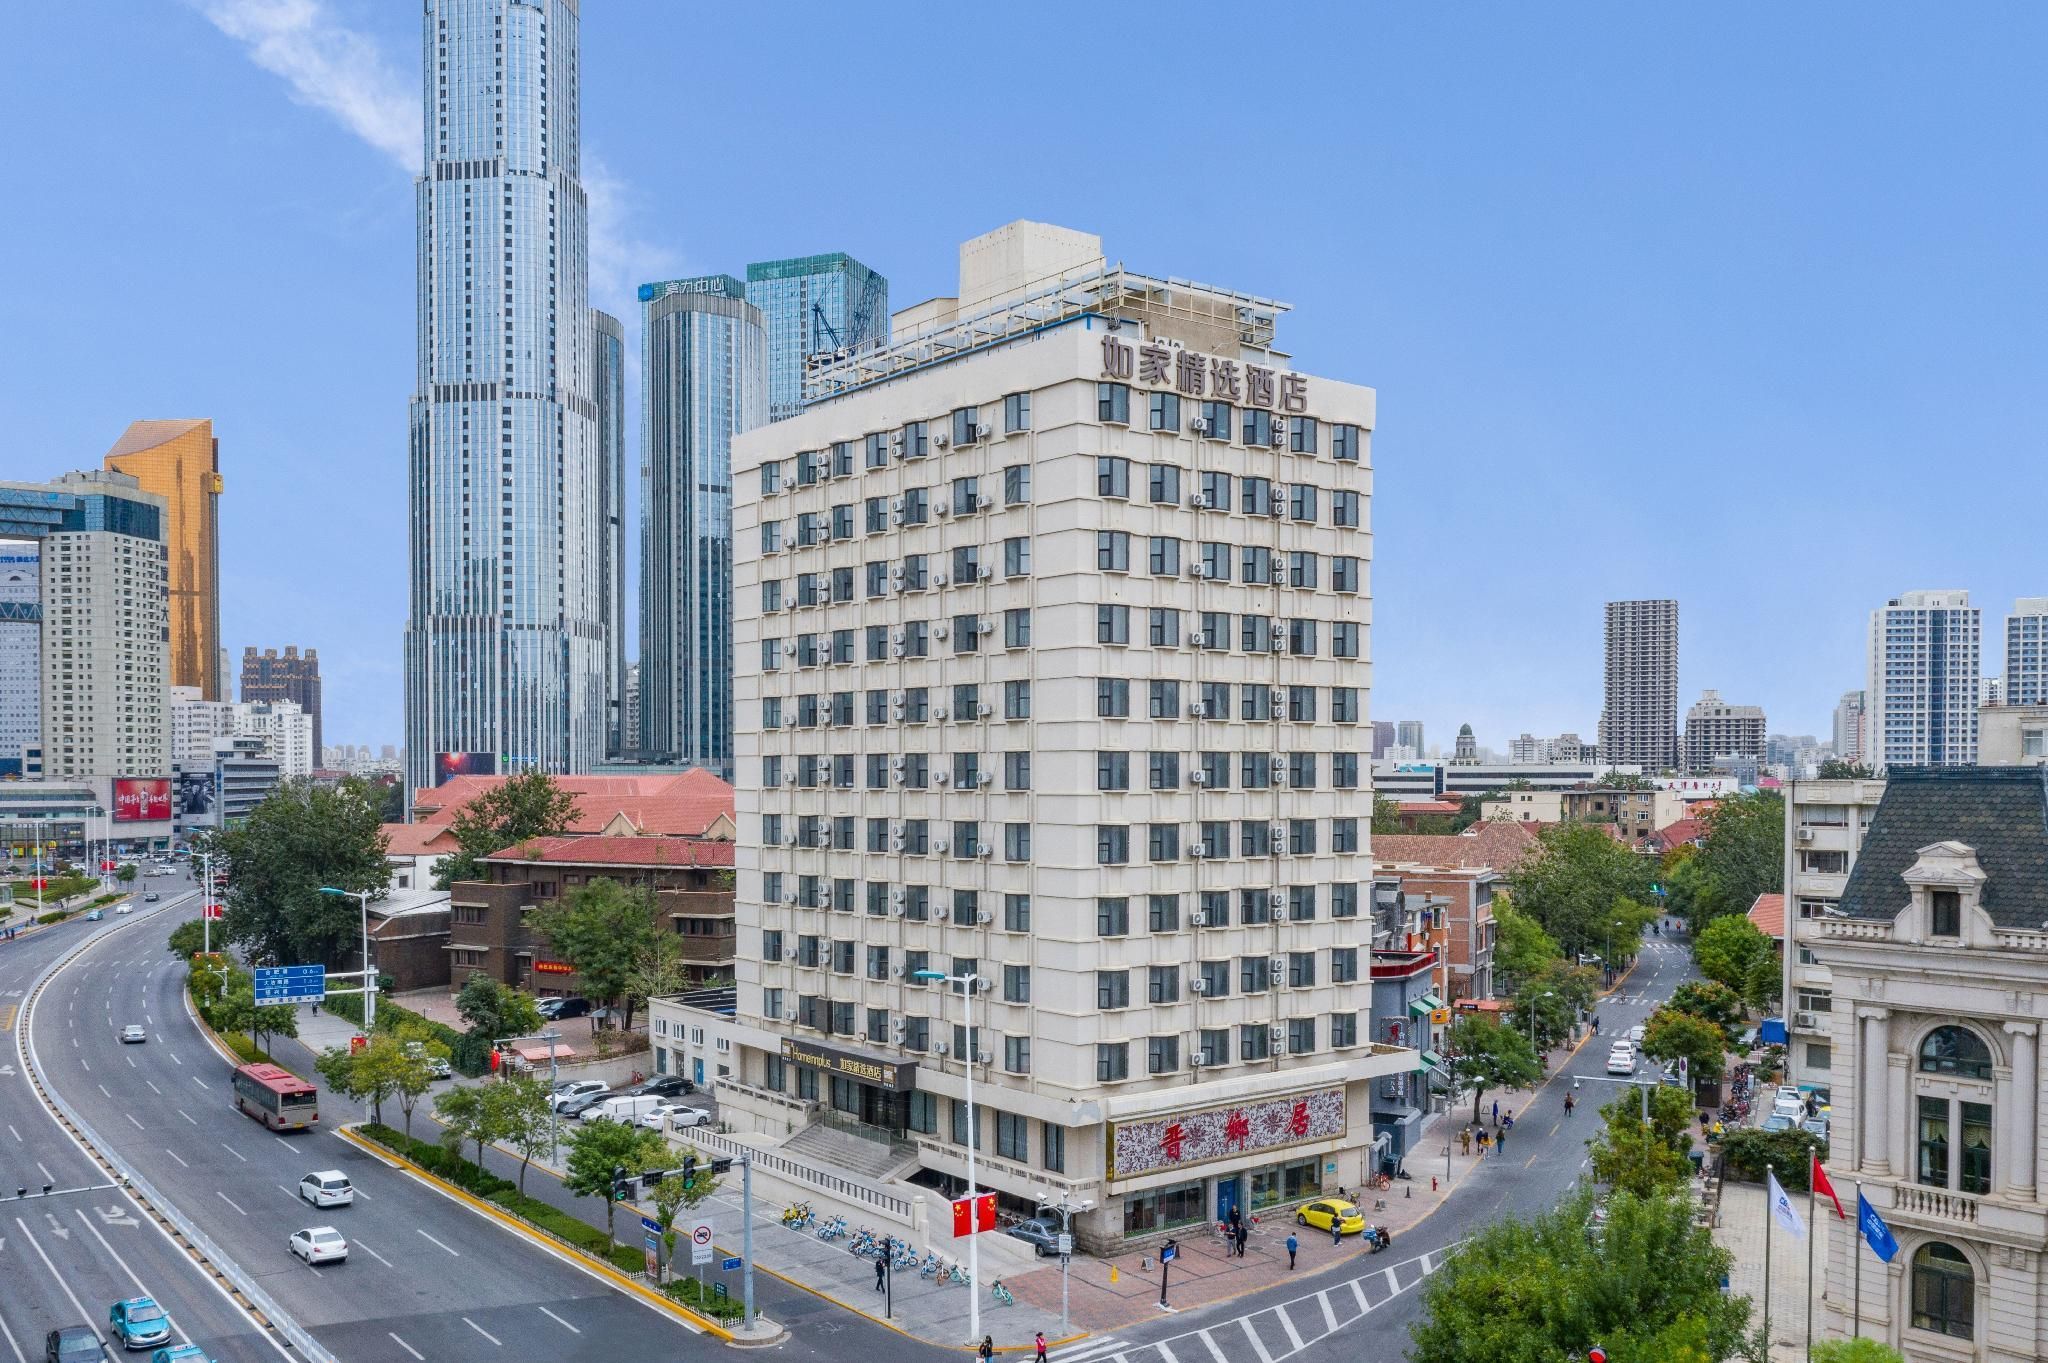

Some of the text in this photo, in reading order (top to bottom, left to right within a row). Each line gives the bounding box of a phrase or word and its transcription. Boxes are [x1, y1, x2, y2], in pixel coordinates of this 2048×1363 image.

[1101, 335, 1308, 412] 如家精选酒店
[839, 1058, 882, 1079] 如家精选酒店
